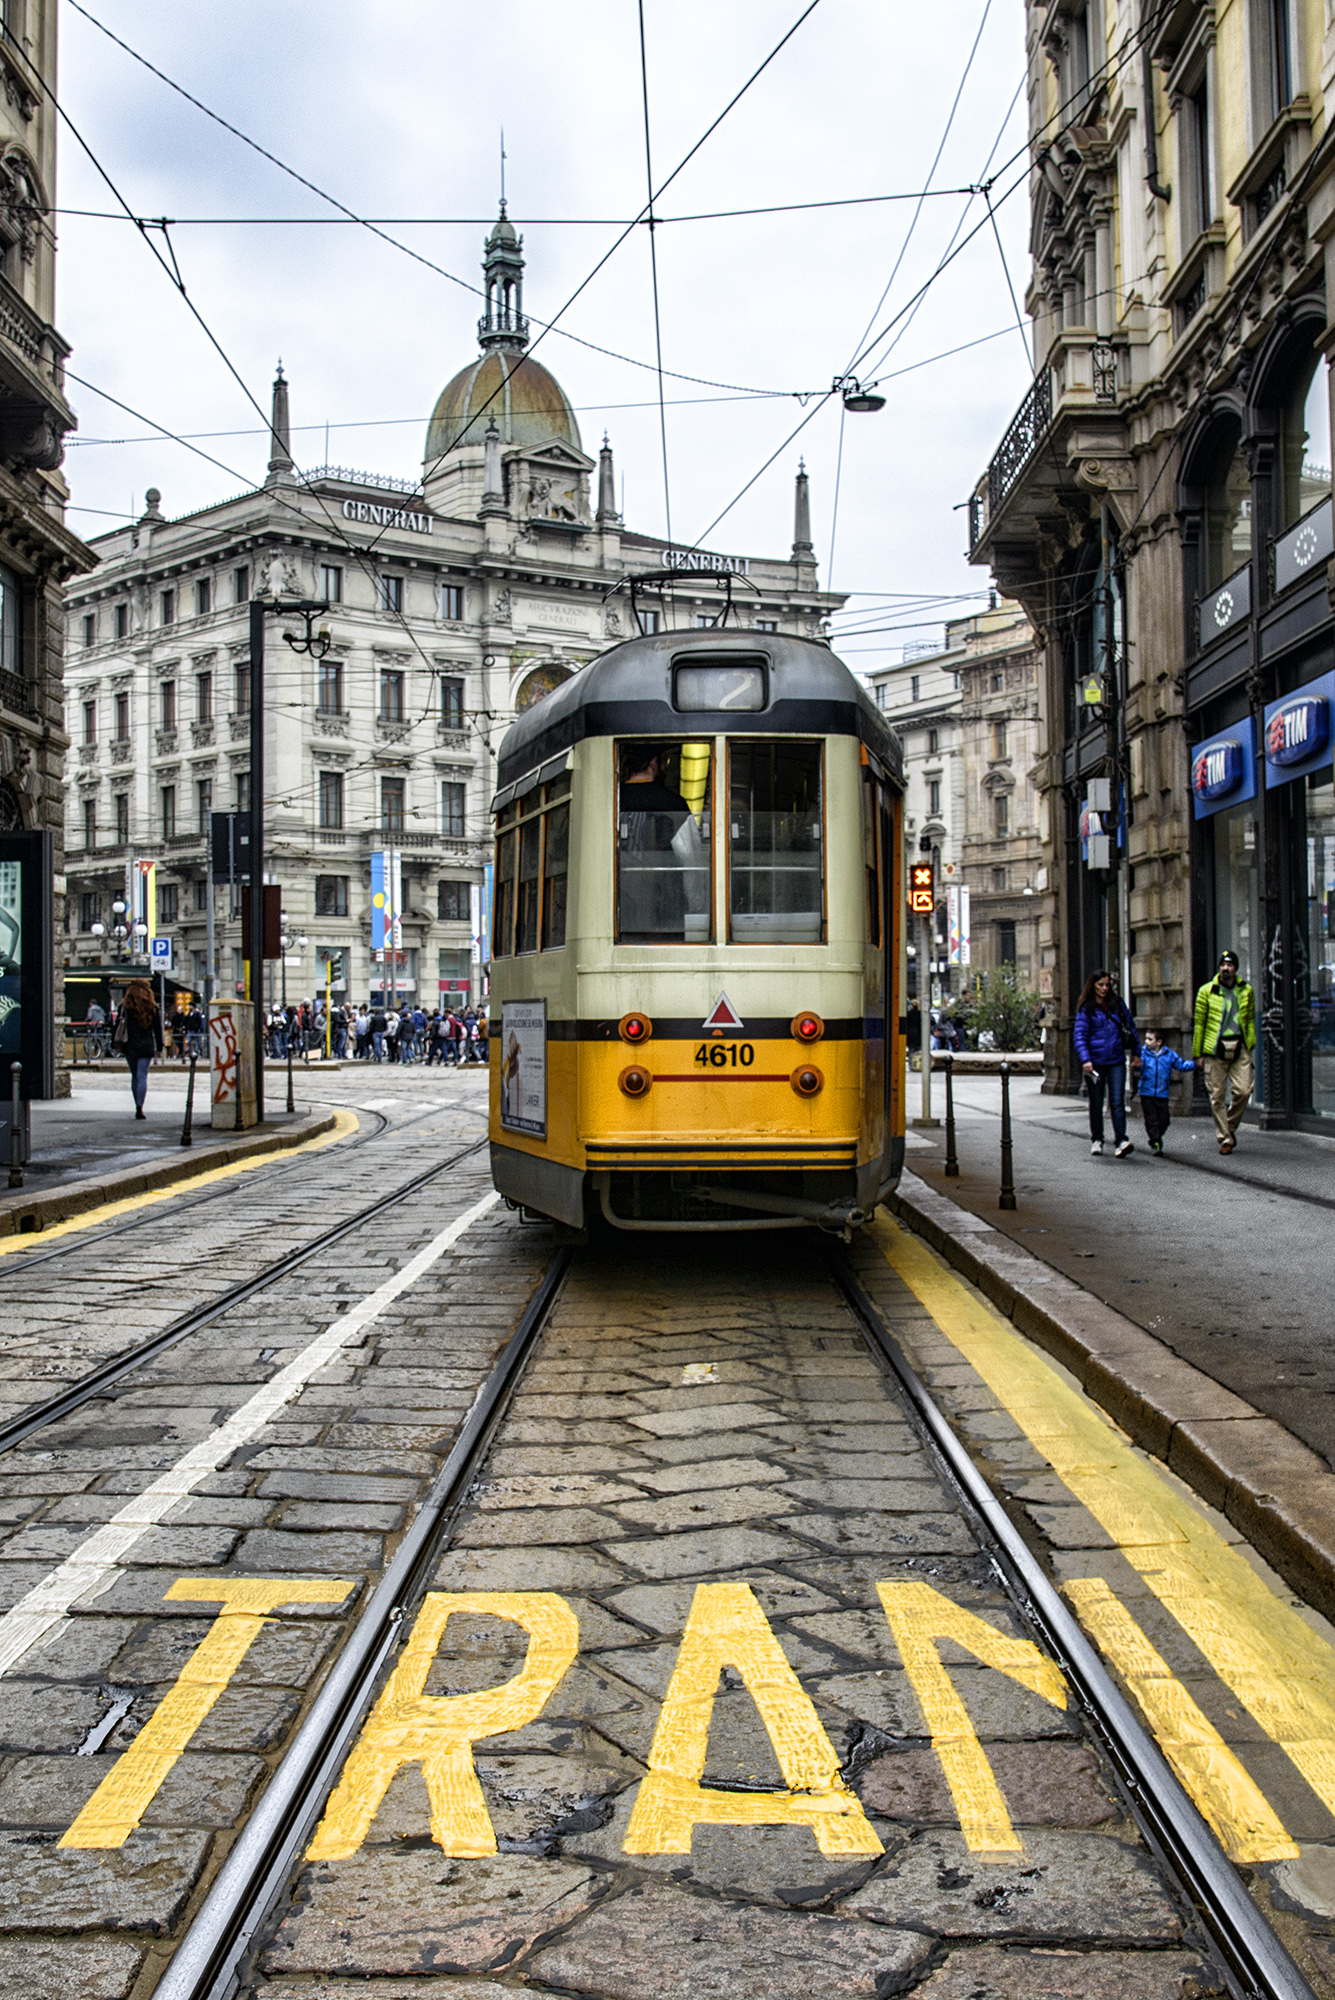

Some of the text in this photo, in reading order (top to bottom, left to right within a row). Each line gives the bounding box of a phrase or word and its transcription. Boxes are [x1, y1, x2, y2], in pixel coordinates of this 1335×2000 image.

[342, 499, 434, 534] GENERALI
[661, 549, 750, 576] GENERALI
[538, 614, 578, 625] GENERALI
[719, 669, 756, 710] 2
[1284, 705, 1308, 748] TIM
[1206, 750, 1226, 786] TIM
[155, 941, 167, 955] P
[695, 1043, 754, 1067] 4610
[57, 1577, 1301, 1865] TRAM
